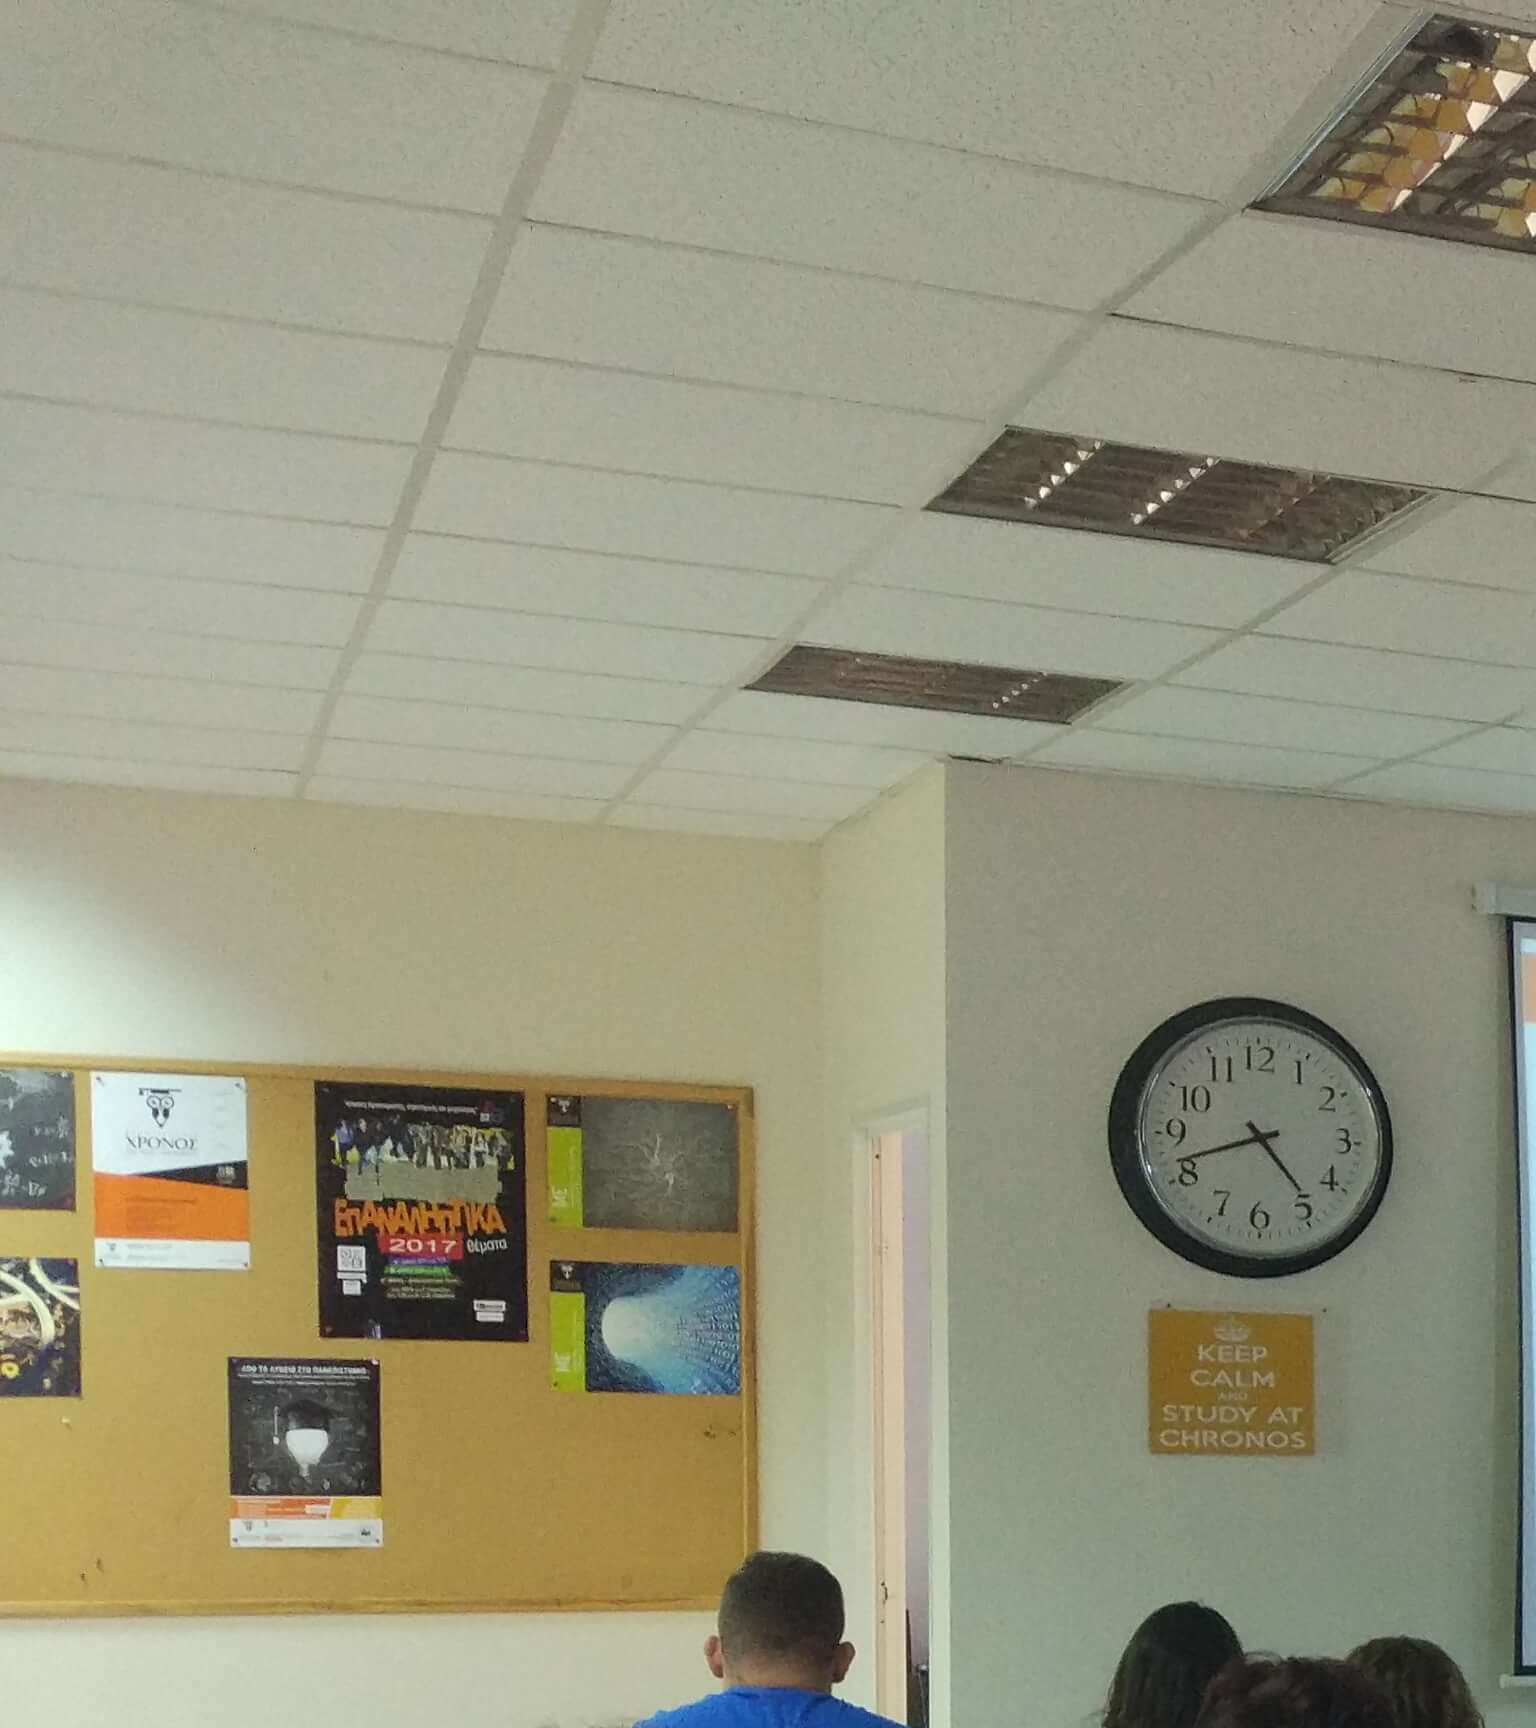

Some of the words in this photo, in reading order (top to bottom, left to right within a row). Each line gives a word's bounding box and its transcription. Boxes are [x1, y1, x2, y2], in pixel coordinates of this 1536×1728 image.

[1210, 1055, 1232, 1082] 11
[1246, 1045, 1274, 1073] 12
[1296, 1060, 1302, 1084] 1
[1180, 1084, 1211, 1113] 10
[1318, 1086, 1336, 1112] 2
[125, 1135, 198, 1151] ΧΡΟΝΟΣ
[1166, 1118, 1186, 1146] 9
[1336, 1128, 1351, 1154] 3
[1177, 1158, 1198, 1186] 8
[1320, 1164, 1339, 1191] 4
[1213, 1189, 1231, 1216] 7
[1250, 1201, 1270, 1229] 6
[1295, 1193, 1313, 1220] 5
[389, 1238, 457, 1253] 2017
[1197, 1344, 1268, 1363] KEEP
[1190, 1369, 1276, 1389] CALM
[1162, 1404, 1257, 1424] STUDY
[1267, 1406, 1304, 1424] AT
[1159, 1429, 1307, 1448] CHRONOS
